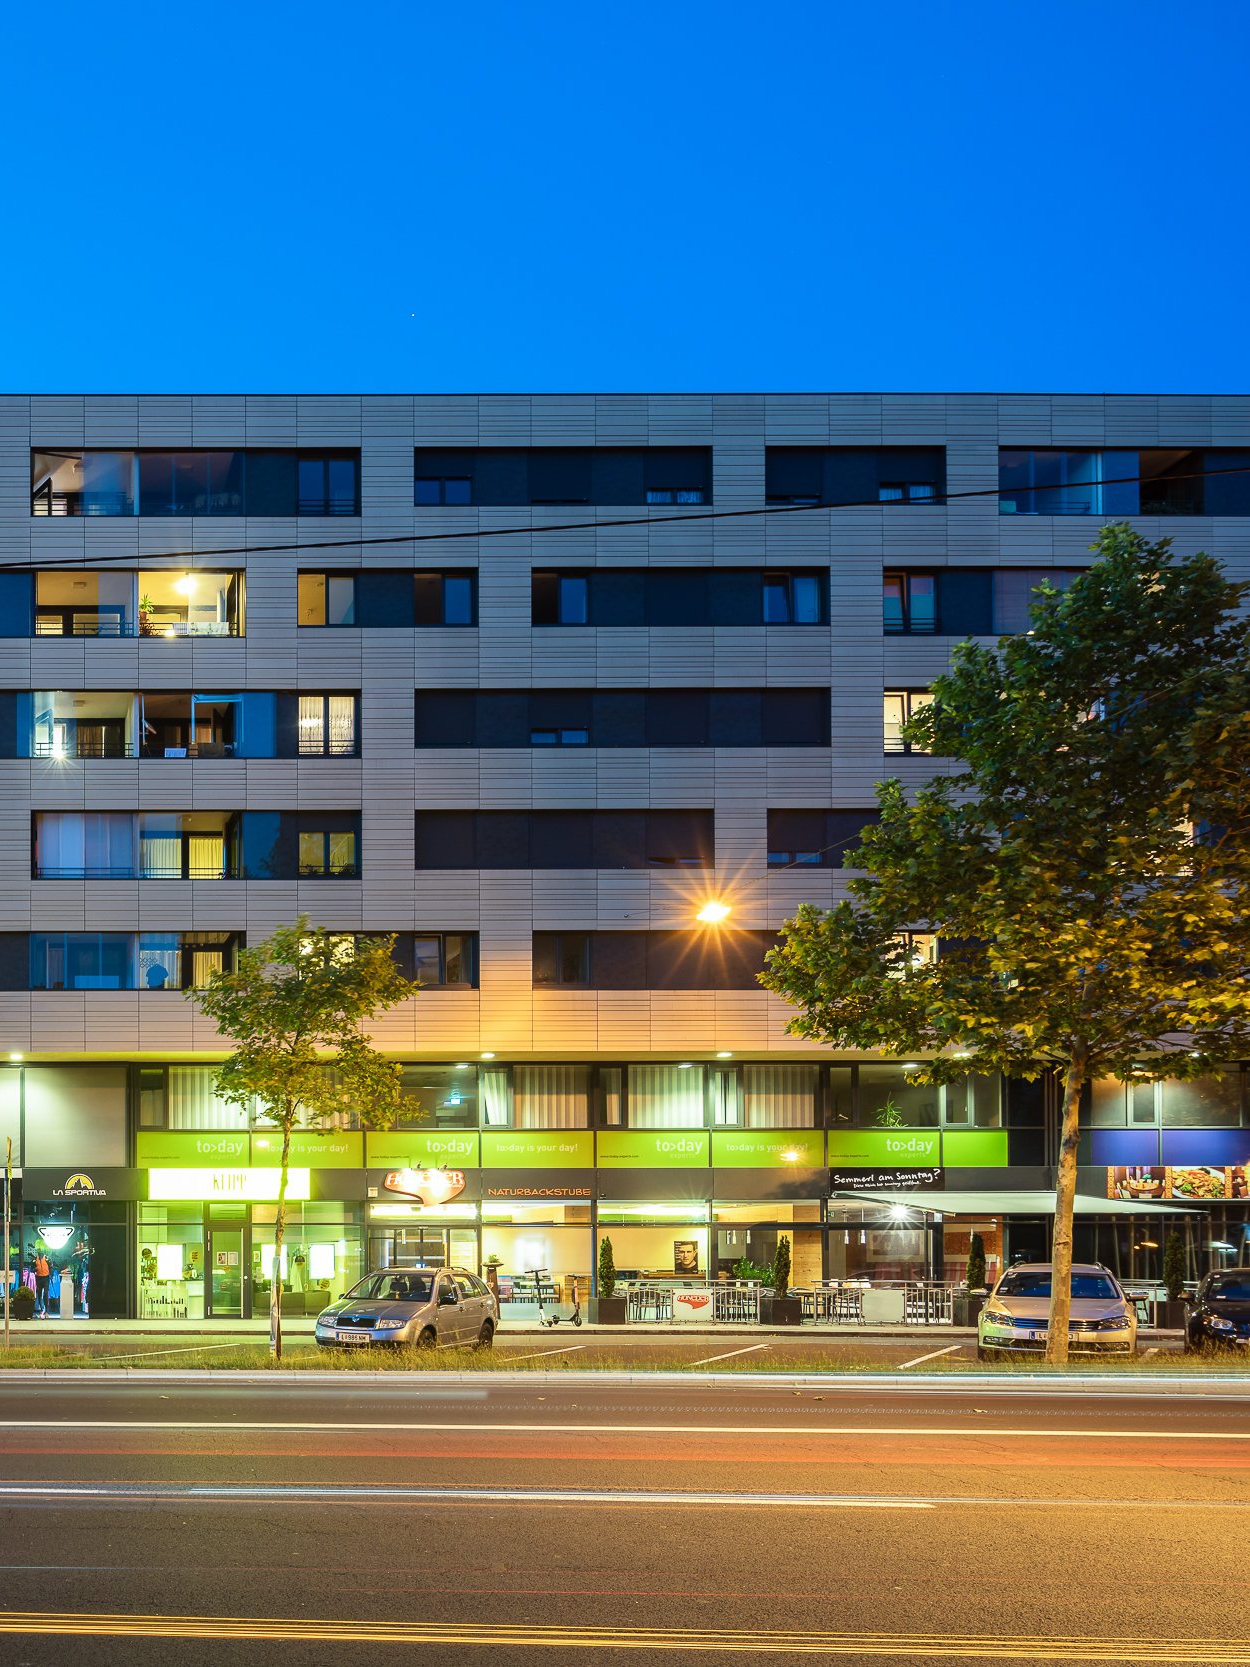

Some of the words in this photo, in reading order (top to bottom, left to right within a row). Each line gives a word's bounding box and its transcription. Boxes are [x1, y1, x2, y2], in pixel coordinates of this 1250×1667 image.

[267, 1144, 295, 1153] to>dy
[298, 1143, 304, 1152] is
[307, 1145, 326, 1153] your
[329, 1143, 349, 1153] day!
[527, 1143, 534, 1151] is
[537, 1145, 556, 1153] your
[559, 1143, 578, 1152] day!
[757, 1143, 764, 1152] is
[878, 1174, 893, 1182] am
[896, 1168, 941, 1182] Sonntag?
[488, 1188, 591, 1196] NATURBACKSTUBE
